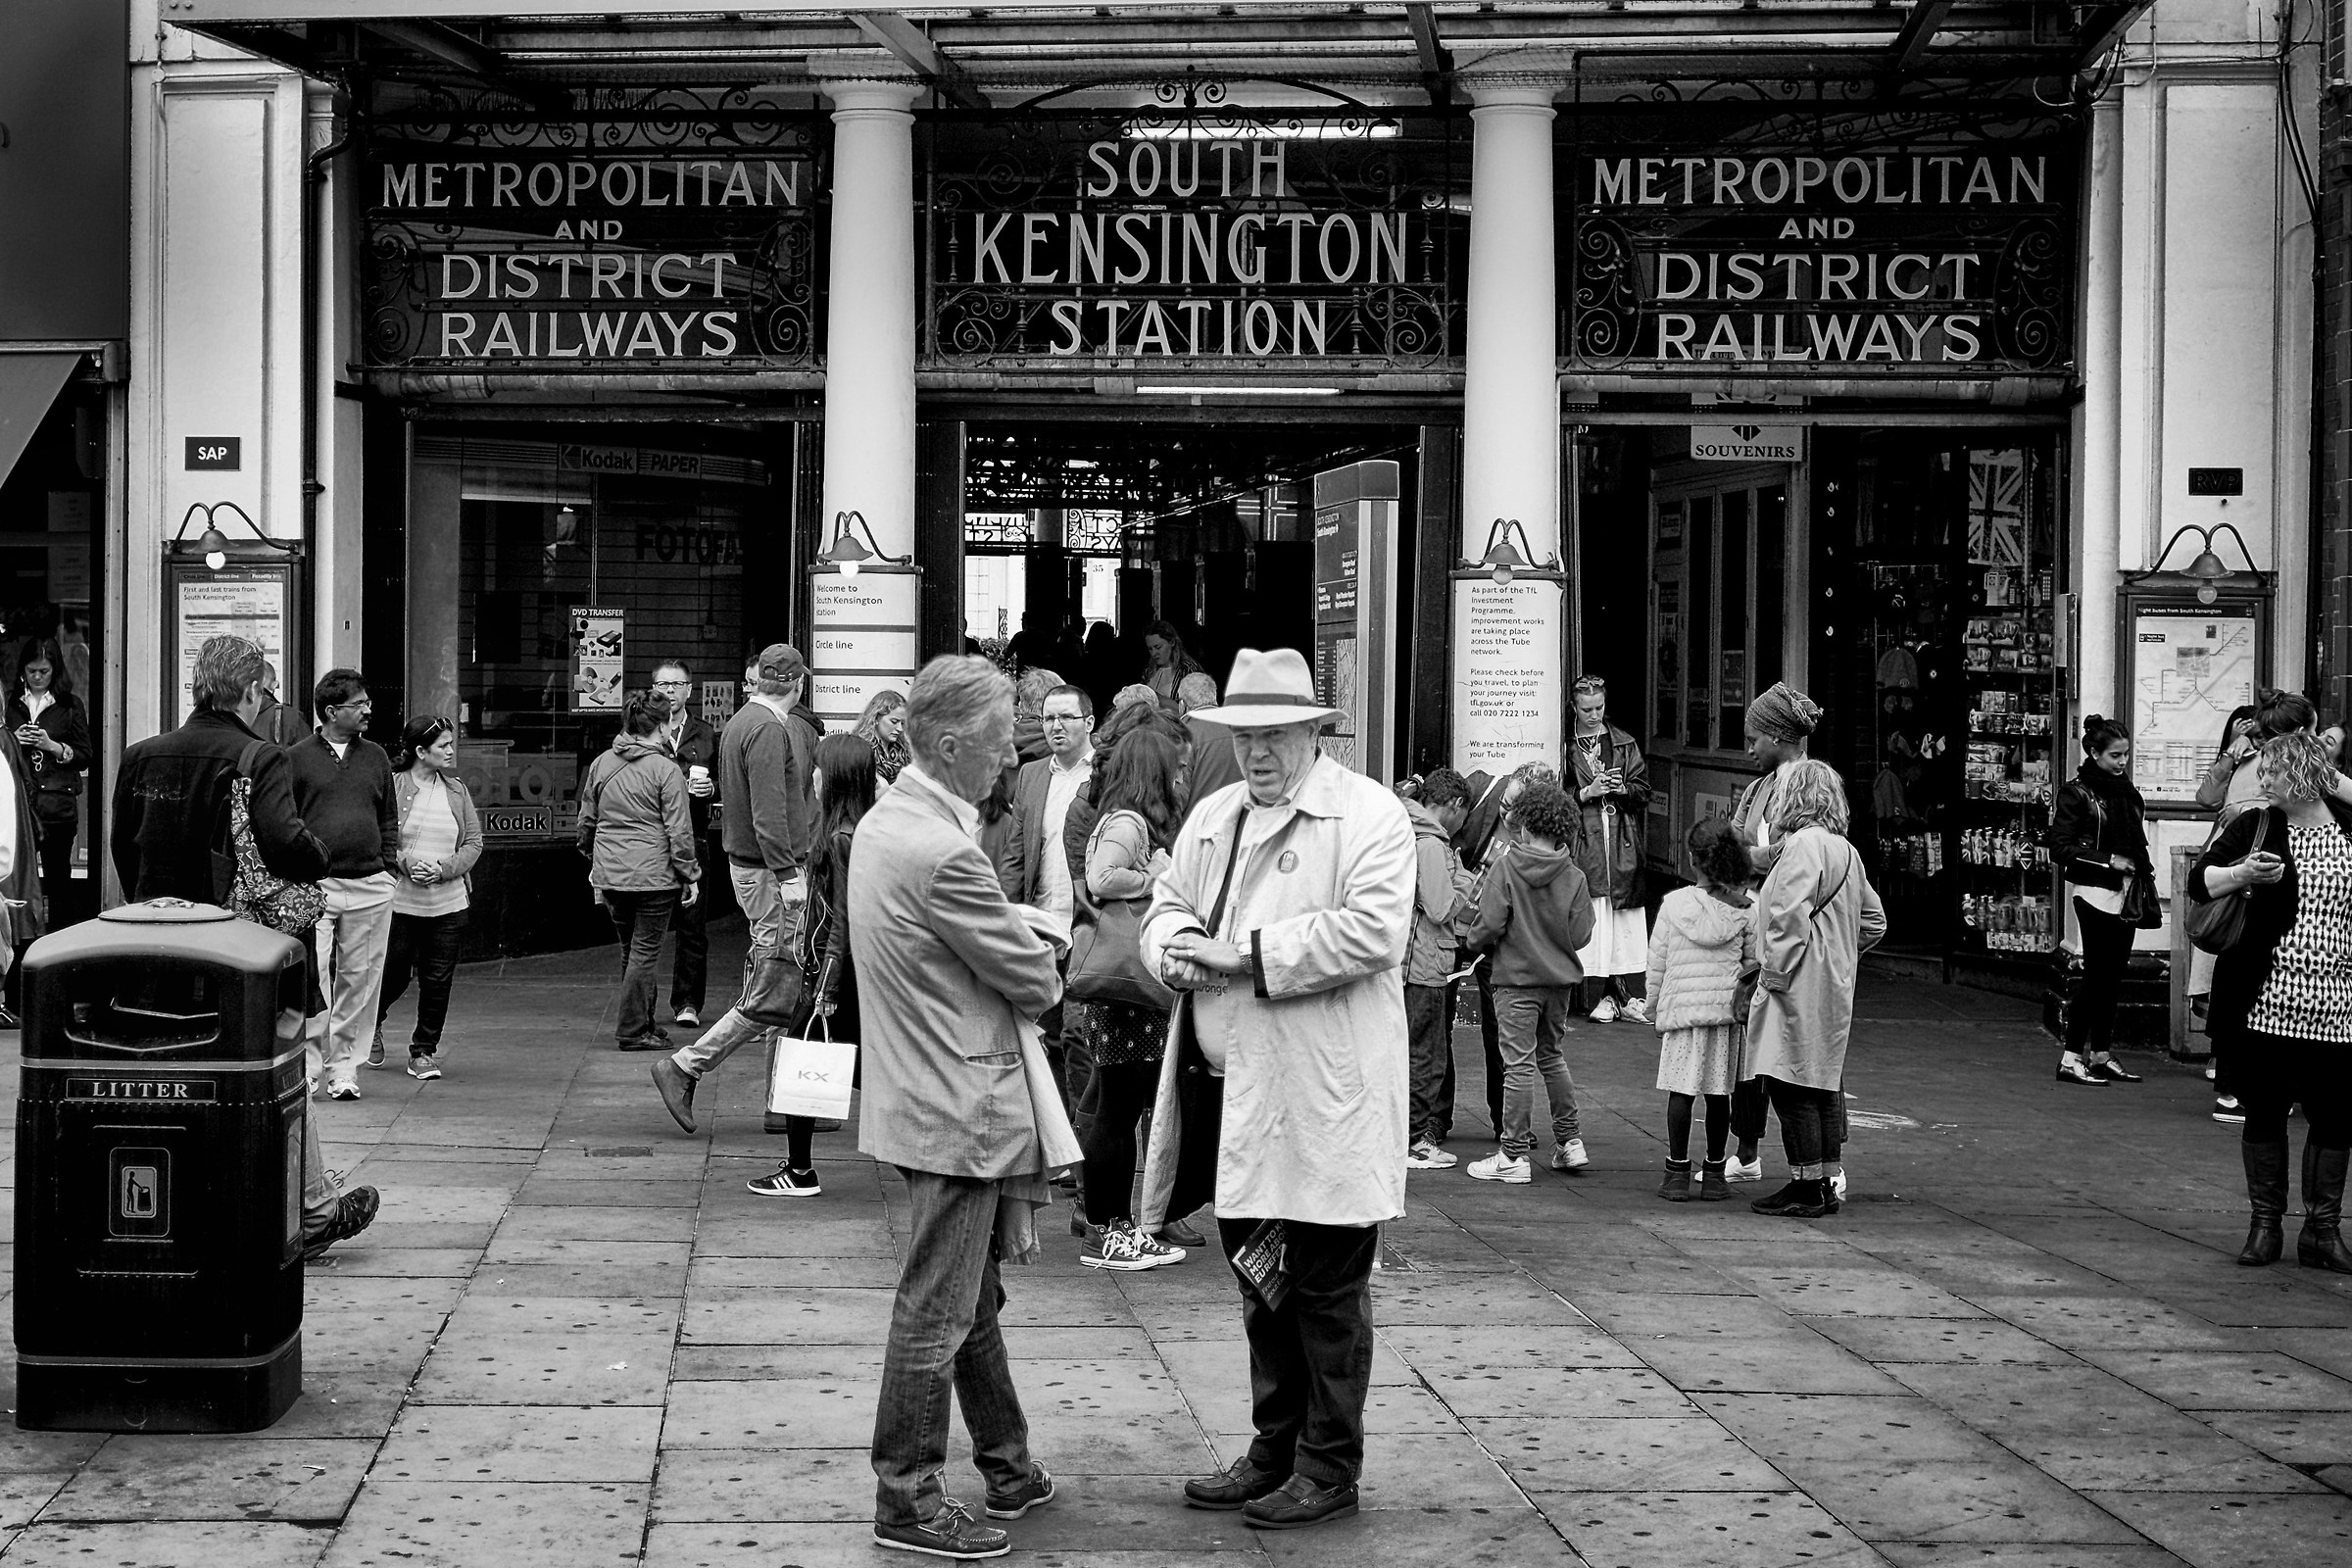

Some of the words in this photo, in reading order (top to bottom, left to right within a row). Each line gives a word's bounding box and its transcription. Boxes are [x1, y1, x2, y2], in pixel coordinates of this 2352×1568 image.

[1087, 141, 1287, 198] SOUTH
[382, 161, 800, 209] METROPOLITAN
[1593, 156, 2045, 206] METROPOLITAN
[554, 220, 623, 241] AND
[1779, 217, 1855, 239] AND
[972, 212, 1408, 285] KENSINGTON
[440, 253, 738, 300] DISTRICT
[1656, 253, 1982, 301] DISTRICT
[440, 311, 738, 359] RAILWAYS
[1050, 300, 1326, 357] STATION
[1656, 314, 1982, 363] RAILWAYS
[198, 446, 227, 461] SAP
[1695, 444, 1795, 459] SOUVENIRS
[581, 449, 633, 470] Kodak
[651, 454, 700, 474] PAPER
[1093, 564, 1104, 573] 35
[816, 584, 846, 593] Welcome
[848, 584, 858, 593] to
[815, 596, 832, 605] South
[833, 596, 883, 606] Kensington
[815, 608, 836, 616] station
[1471, 617, 1522, 626] improvement
[1483, 627, 1507, 636] taking
[1509, 627, 1531, 636] place
[815, 640, 833, 649] Circle
[835, 640, 854, 650] line
[815, 684, 840, 694] District
[842, 684, 861, 694] line
[1522, 679, 1539, 688] plan
[1496, 740, 1545, 750] transforming
[1487, 750, 1506, 759] Tube
[486, 812, 548, 832] Kodak
[798, 1070, 829, 1083] KX
[92, 1081, 188, 1099] LITTER
[1244, 1240, 1267, 1268] WANT
[1264, 1229, 1277, 1245] TO
[1249, 1249, 1272, 1277] MORE
[1253, 1268, 1266, 1284] EU
